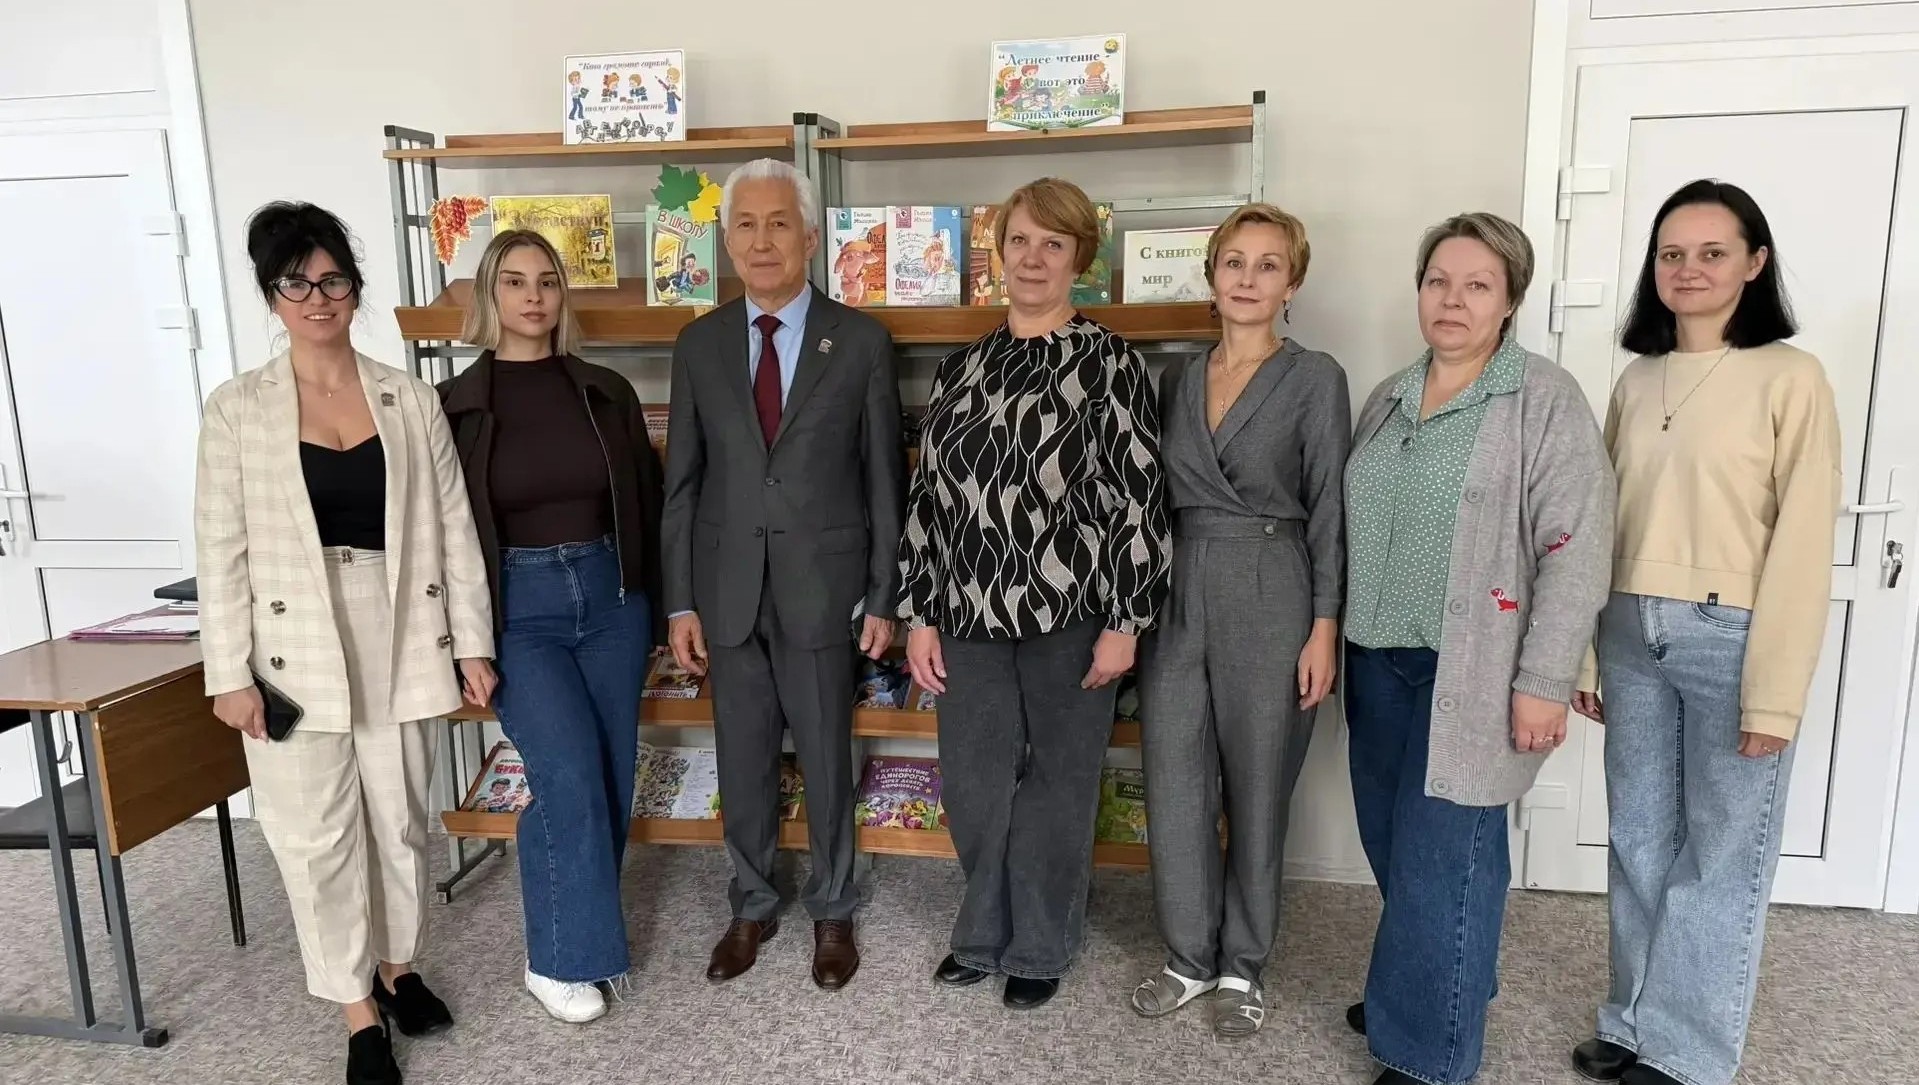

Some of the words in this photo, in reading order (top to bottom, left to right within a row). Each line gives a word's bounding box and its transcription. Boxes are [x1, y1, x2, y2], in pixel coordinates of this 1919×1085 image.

[1056, 53, 1100, 63] чтение
[1039, 79, 1060, 87] вот
[1065, 77, 1085, 86] это
[657, 210, 667, 223] В
[1140, 246, 1151, 259] С
[1142, 274, 1173, 288] мир
[875, 772, 931, 783] ЕДИНОРОГОВ
